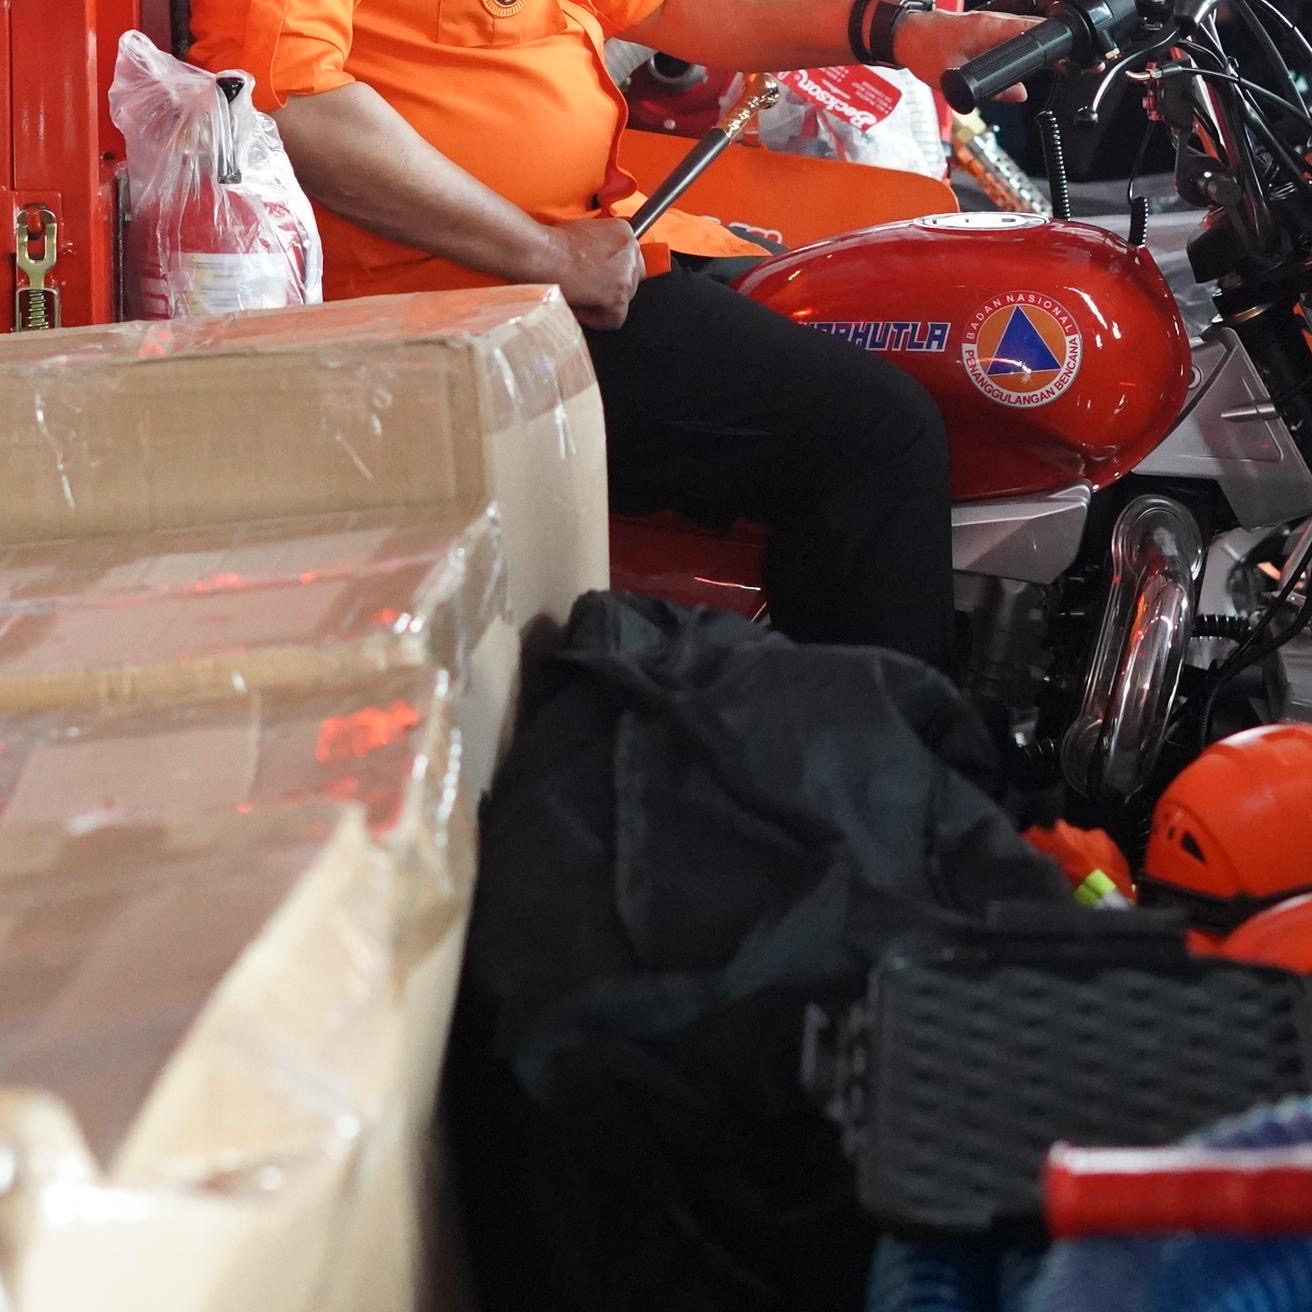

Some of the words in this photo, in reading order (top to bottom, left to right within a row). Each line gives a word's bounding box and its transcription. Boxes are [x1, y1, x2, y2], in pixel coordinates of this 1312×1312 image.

[797, 69, 877, 129] Beckson
[966, 299, 1002, 339] BADAN
[1006, 294, 1072, 332] NASIONAL
[965, 350, 1056, 405] PENANGGULANGAN
[1054, 337, 1079, 391] BENCANA
